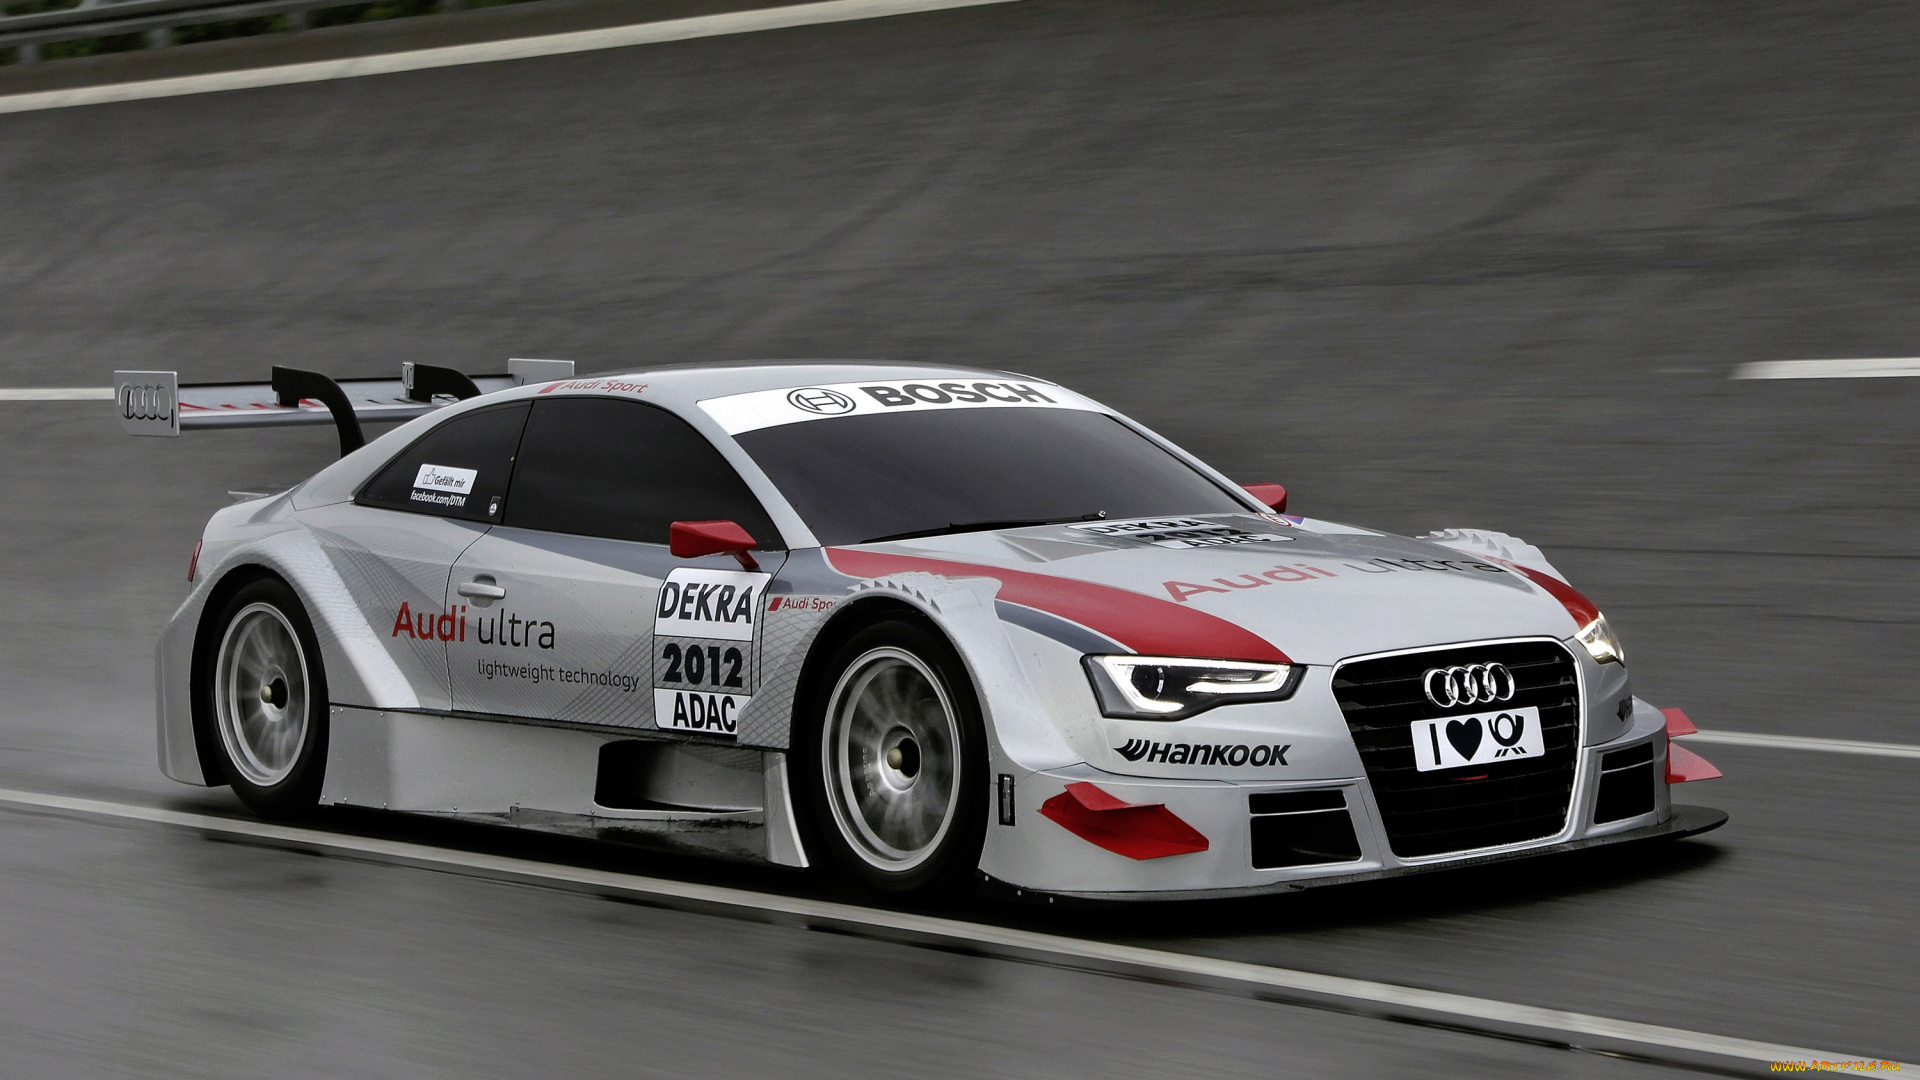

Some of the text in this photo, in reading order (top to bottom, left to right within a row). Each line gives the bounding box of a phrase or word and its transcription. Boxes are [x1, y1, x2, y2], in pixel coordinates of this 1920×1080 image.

[561, 380, 648, 394] Audi Sport
[858, 383, 1058, 407] BOSCH
[435, 476, 466, 488] Gefällt mir
[410, 490, 466, 506] facebook.com/DTM
[1087, 519, 1214, 535] DEKRA
[1136, 528, 1255, 541] 2012
[1162, 558, 1508, 602] Audi ultra
[658, 582, 752, 624] DEKRA
[783, 597, 809, 609] Audi
[392, 602, 556, 650] Audi ultra
[478, 659, 640, 692] lightweight technology
[662, 643, 743, 688] 2012
[673, 692, 737, 732] ADAC
